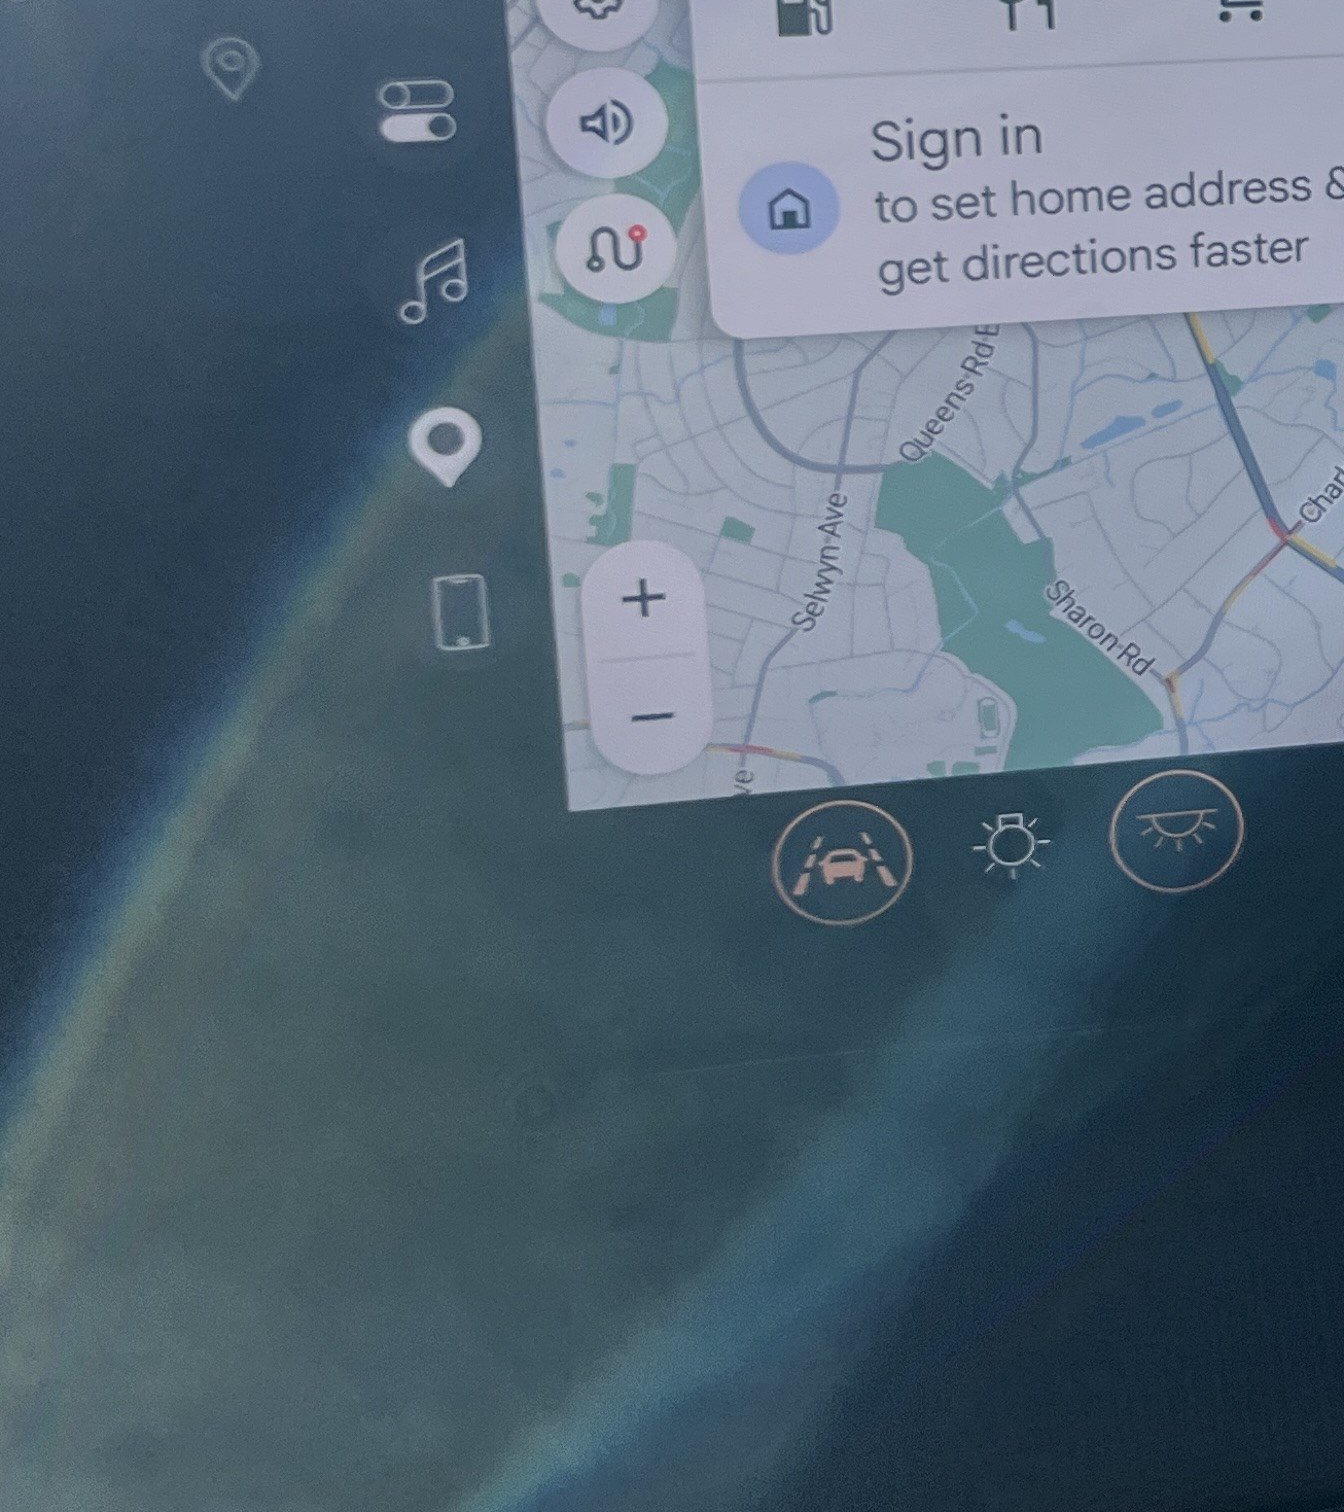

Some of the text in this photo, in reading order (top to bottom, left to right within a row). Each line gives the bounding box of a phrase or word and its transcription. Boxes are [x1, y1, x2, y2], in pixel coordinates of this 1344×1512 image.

[871, 113, 1043, 172] Sign in
[874, 188, 918, 225] to
[931, 184, 998, 222] set
[1010, 176, 1133, 217] home
[1144, 167, 1312, 210] address
[878, 230, 1310, 297] get directions faster
[899, 378, 975, 462] Queens
[960, 340, 996, 377] Rd
[789, 489, 850, 634] Selwyn Ave
[1045, 578, 1156, 678] Sharon Rd
